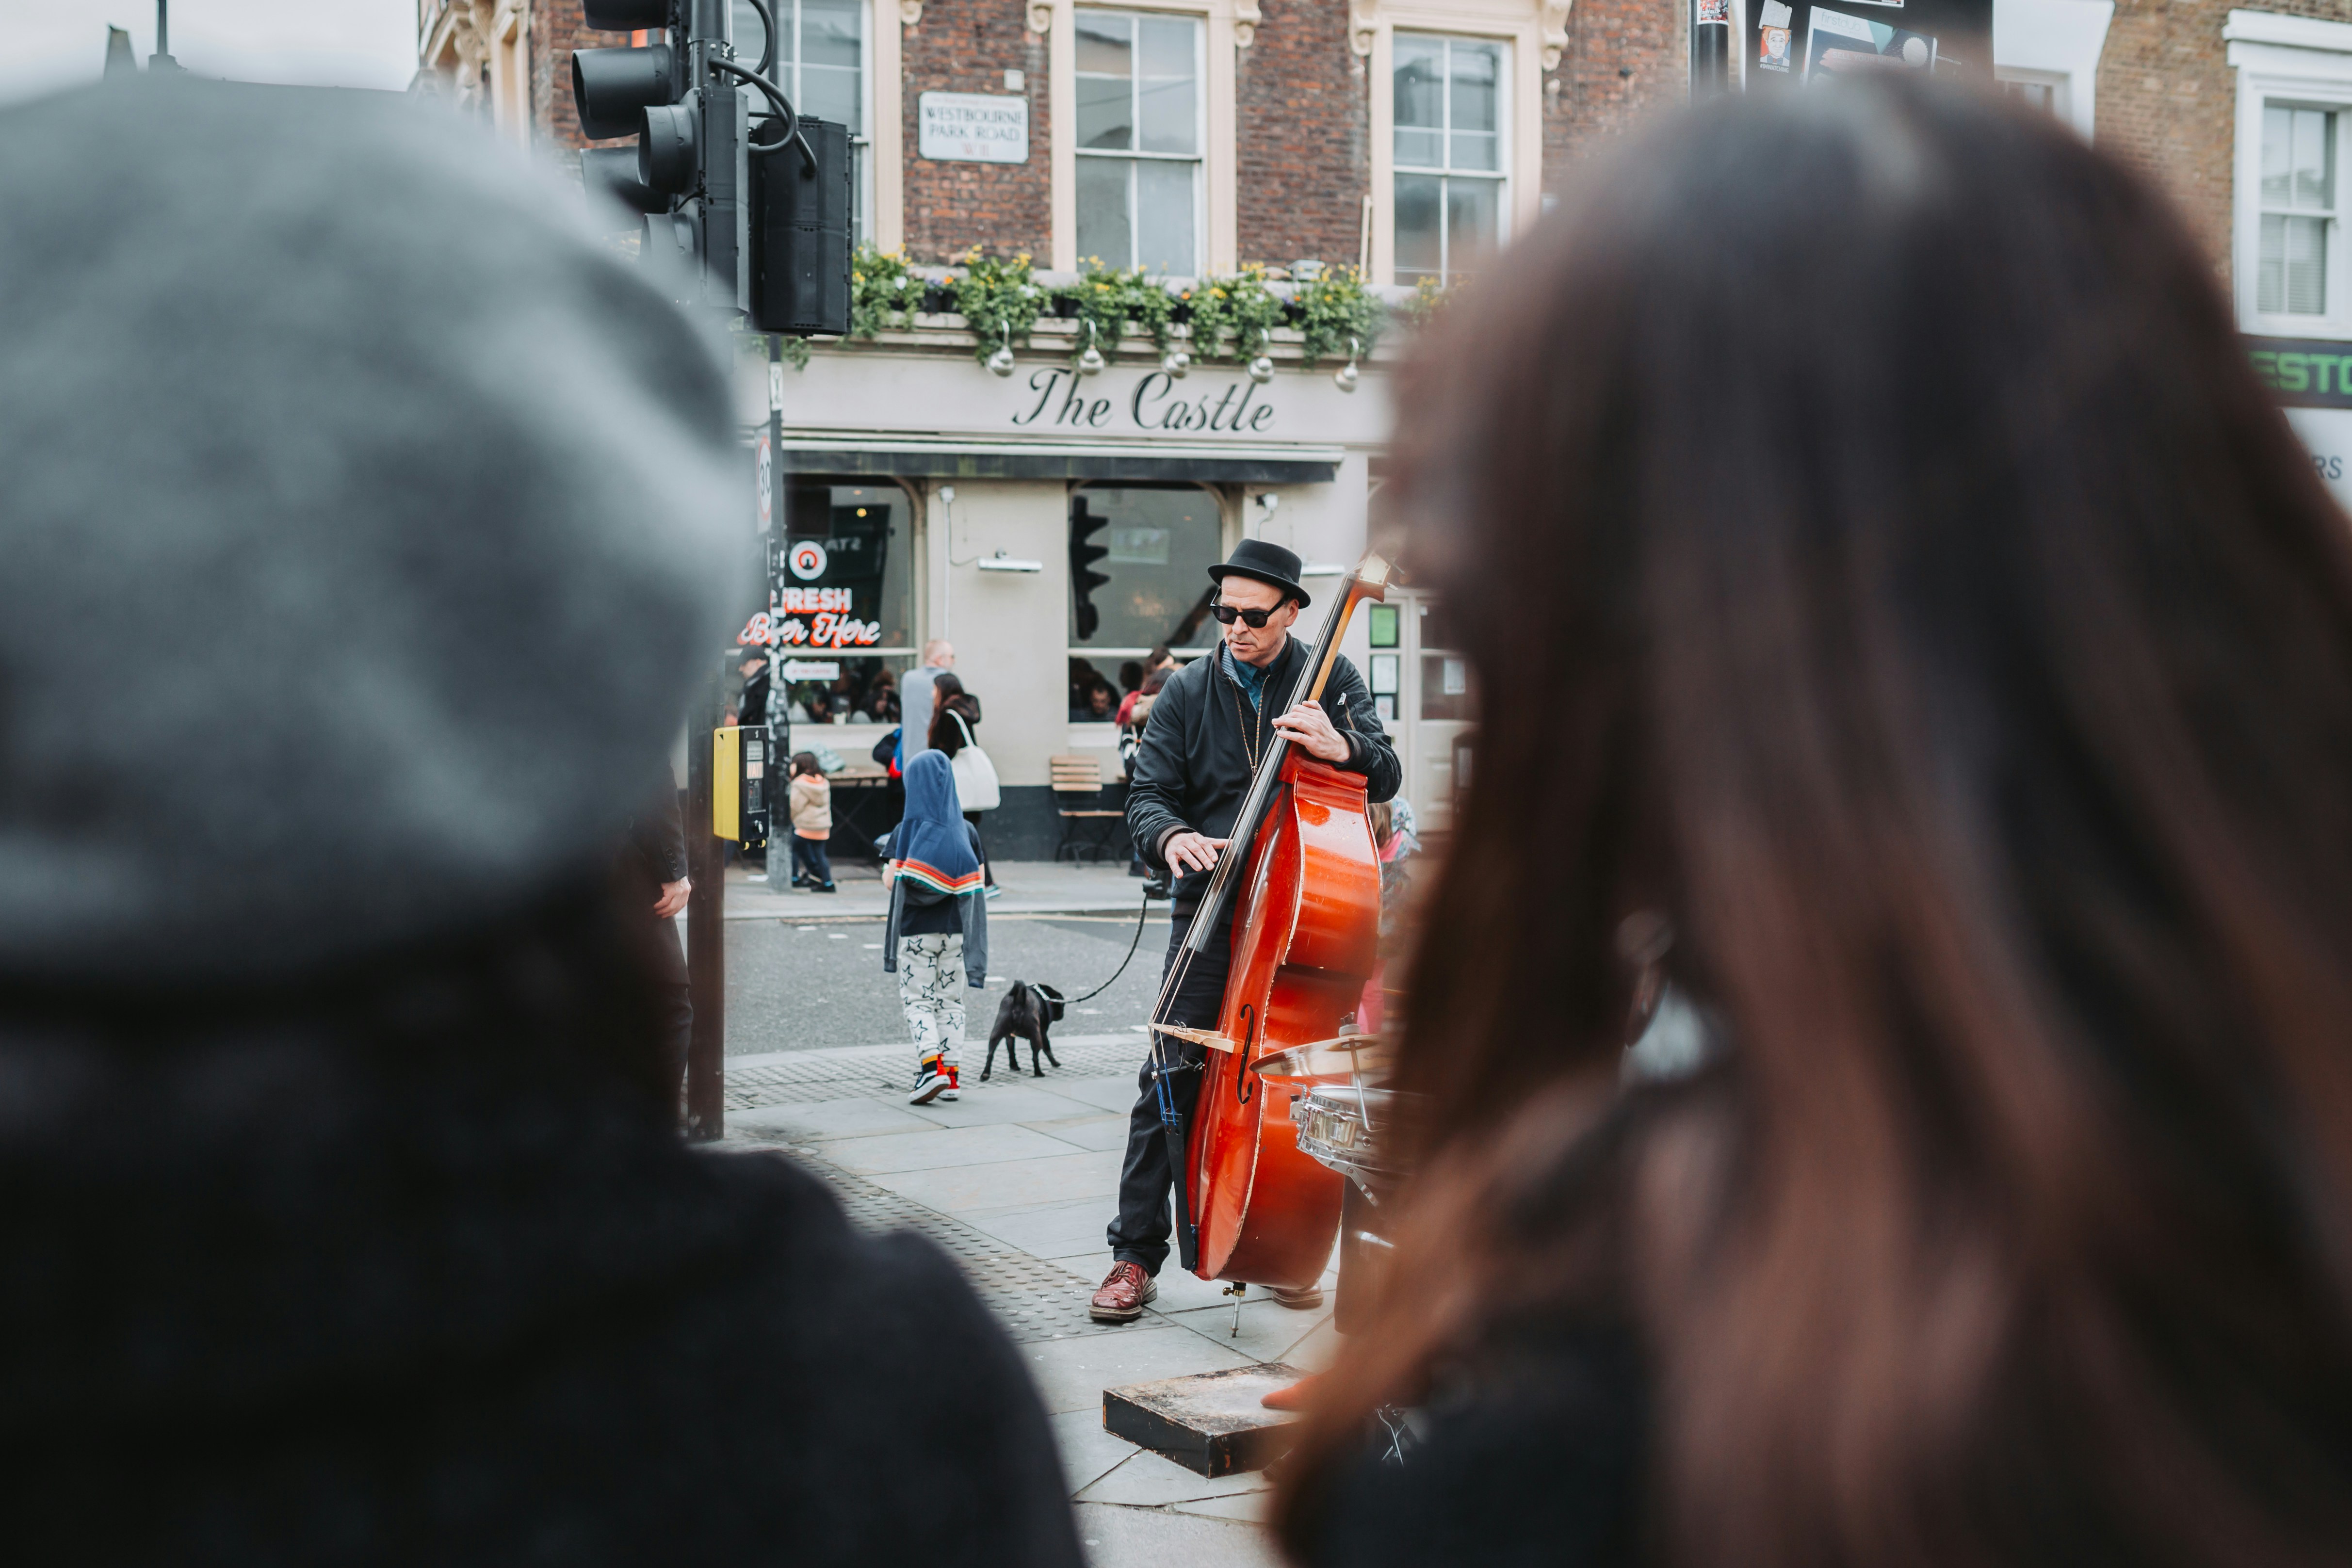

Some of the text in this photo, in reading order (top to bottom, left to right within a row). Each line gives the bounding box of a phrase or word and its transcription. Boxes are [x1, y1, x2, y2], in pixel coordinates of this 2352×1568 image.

[1821, 11, 1861, 31] firstdub
[1831, 51, 1851, 60] SELL
[1853, 54, 1875, 63] YOUR
[926, 107, 1022, 124] WESTBOURNE
[929, 123, 1020, 141] PARK ROAD
[1012, 367, 1275, 432] The Castle
[760, 461, 771, 497] 30
[781, 587, 852, 614] RESH
[810, 611, 881, 649] Here
